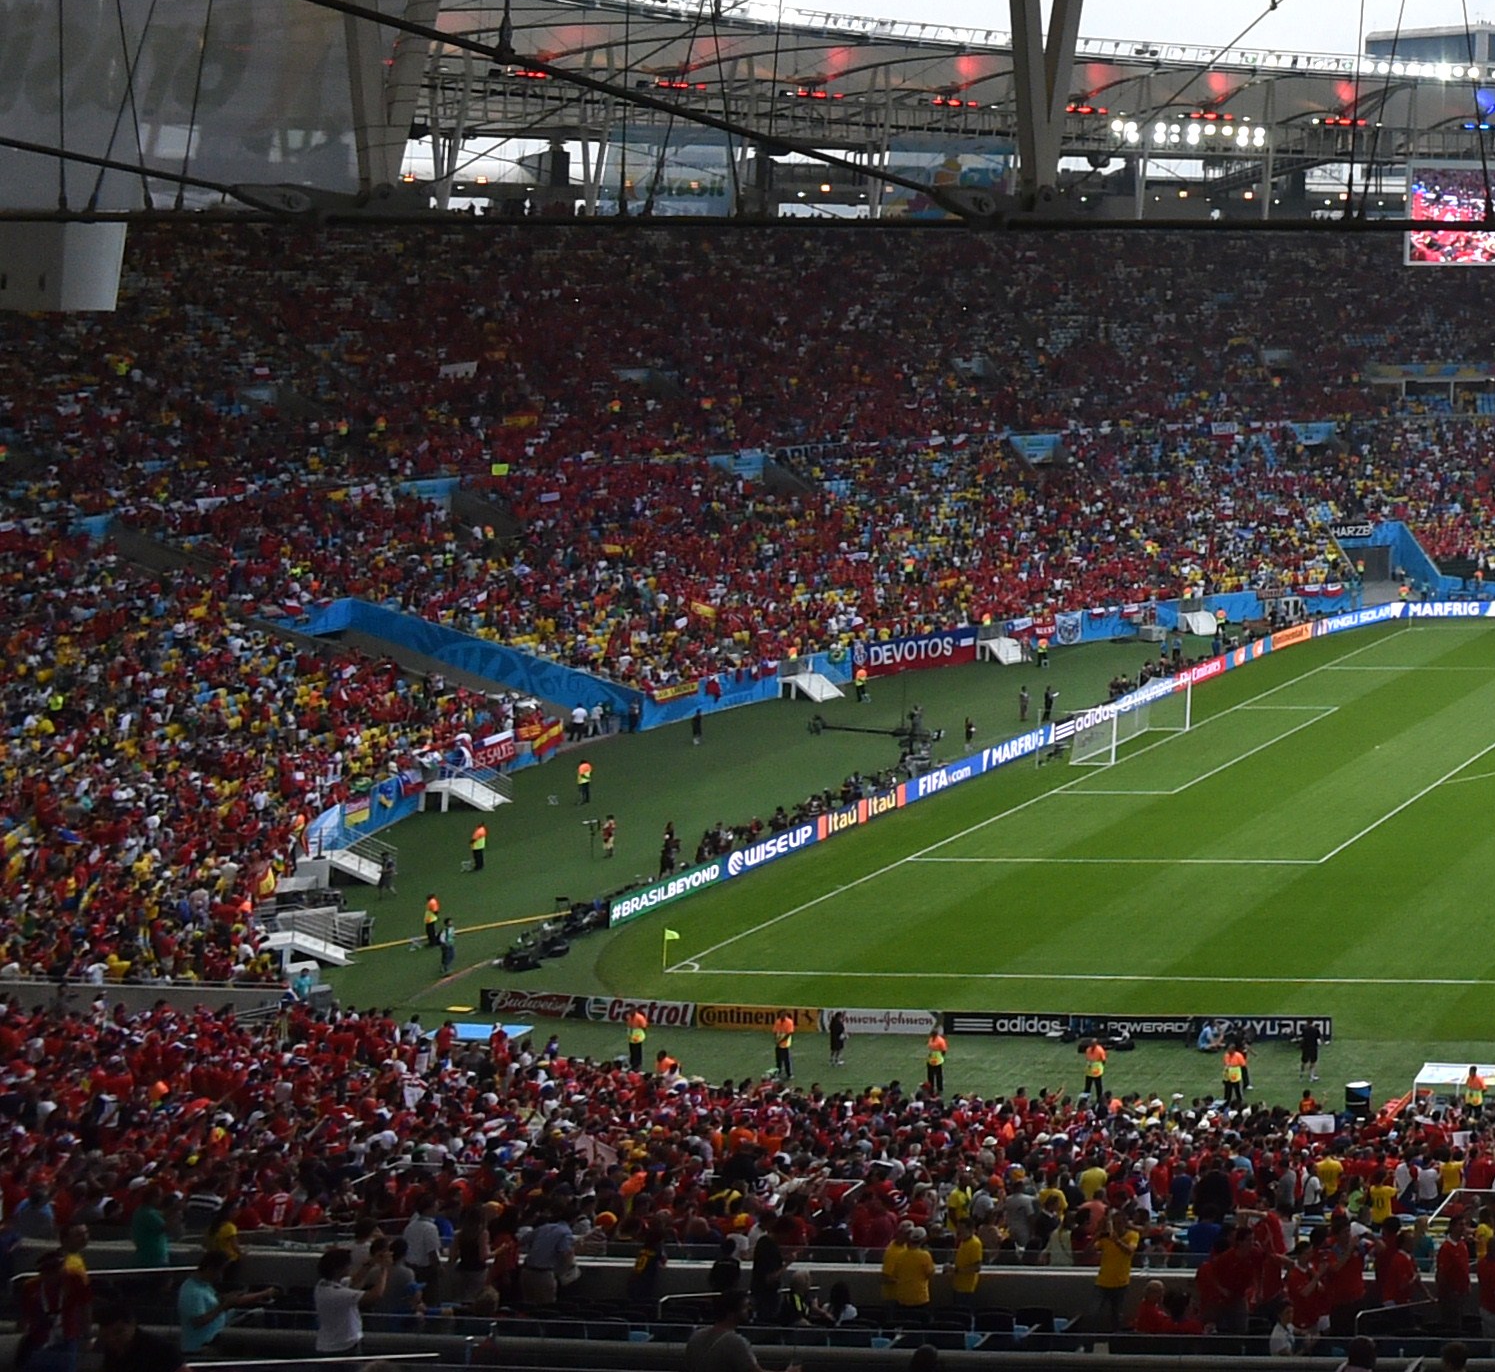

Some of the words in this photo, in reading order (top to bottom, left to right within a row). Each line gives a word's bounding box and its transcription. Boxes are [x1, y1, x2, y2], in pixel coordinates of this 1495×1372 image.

[1411, 602, 1479, 616] MARFRIG
[869, 634, 953, 666] DEVOTOS
[1076, 703, 1117, 732] adidas
[992, 728, 1045, 766] MARFRIG
[868, 790, 896, 817] Itaú
[828, 805, 857, 834] Itaú
[610, 865, 720, 921] #BRASILBEYOND
[488, 990, 576, 1018] Budweiser
[996, 1016, 1060, 1033] adidas
